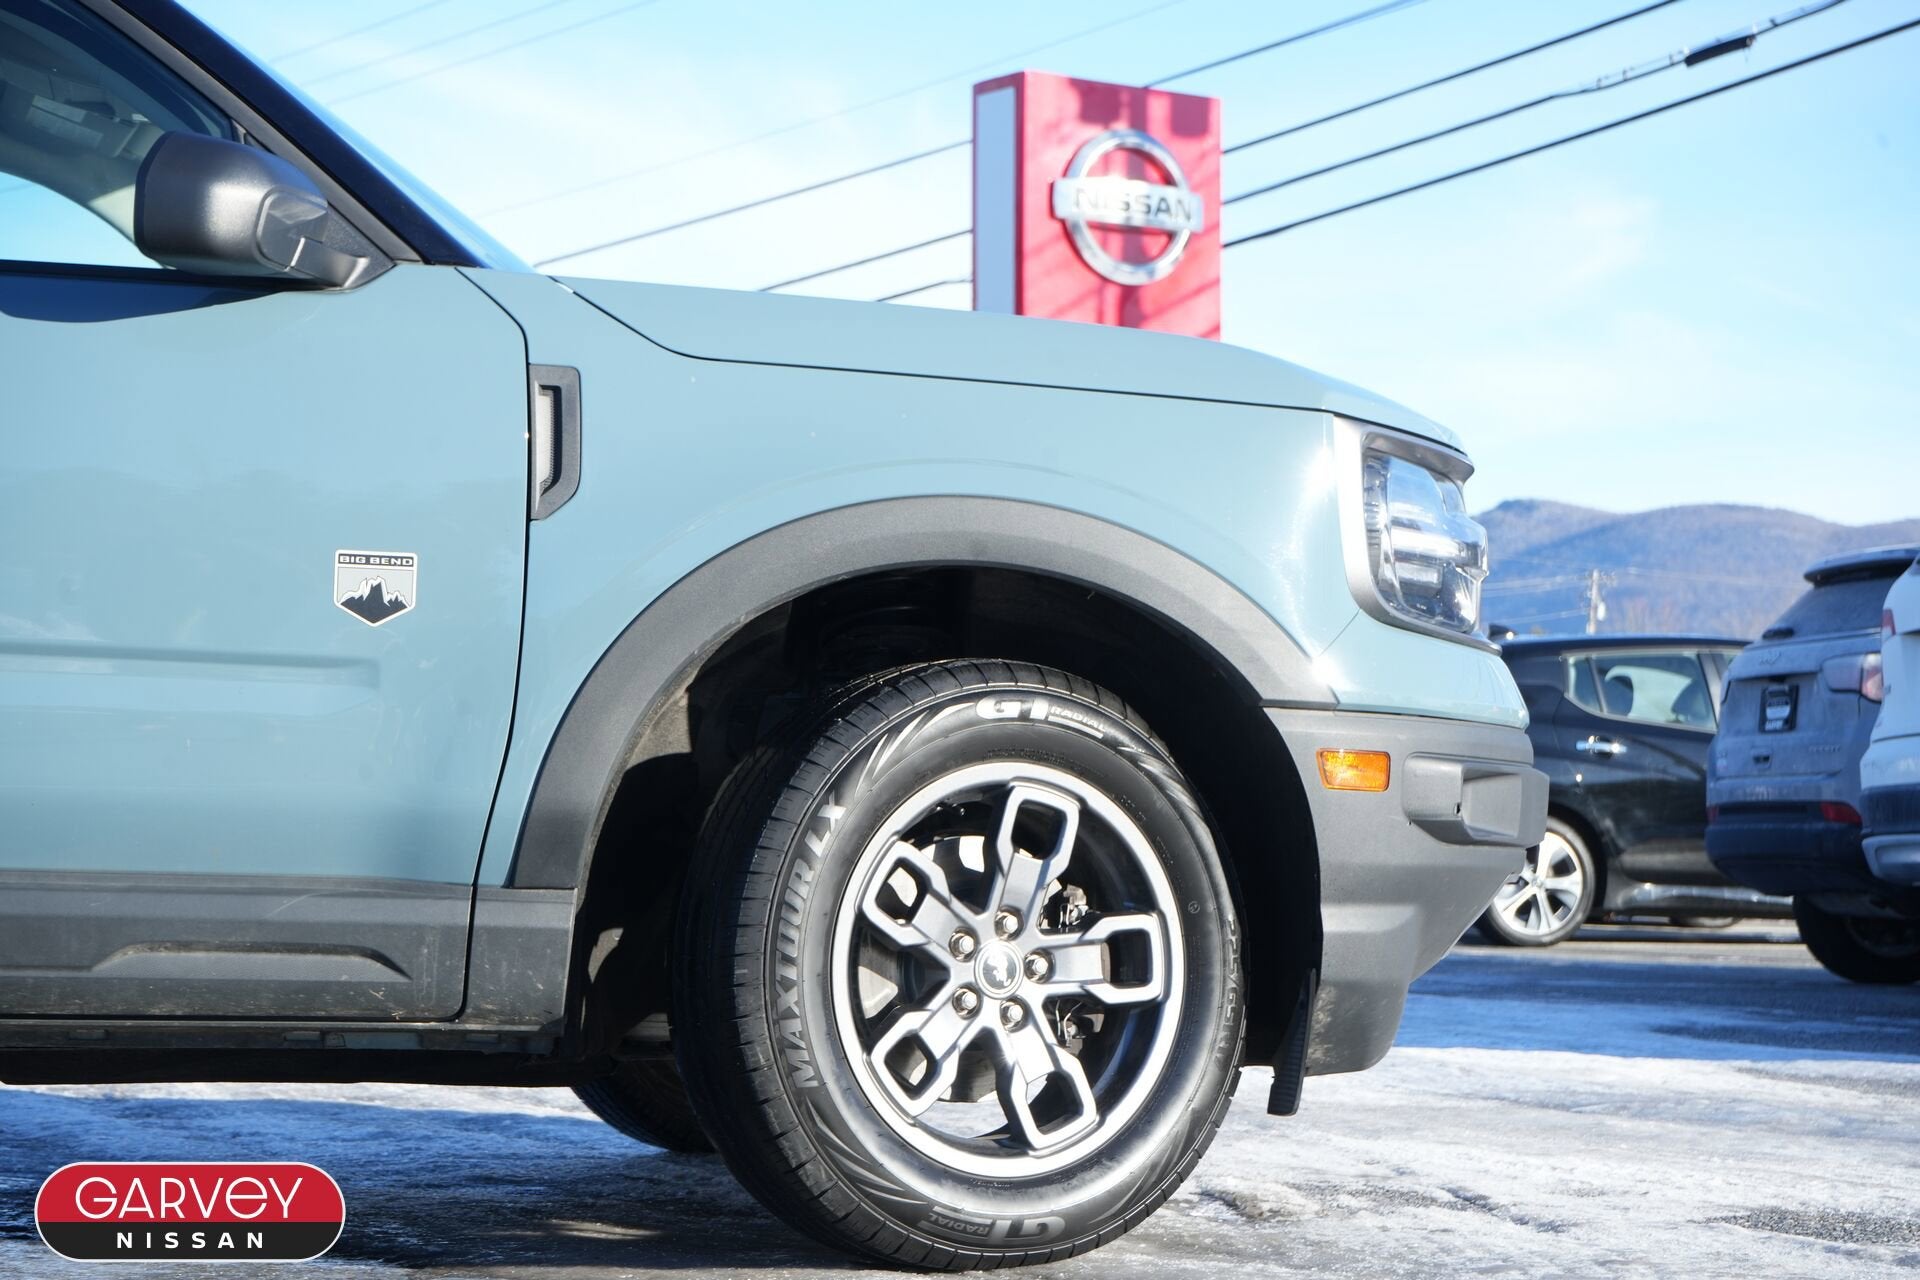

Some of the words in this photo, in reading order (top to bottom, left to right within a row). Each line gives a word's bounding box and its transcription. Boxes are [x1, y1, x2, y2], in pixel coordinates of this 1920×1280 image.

[1074, 187, 1192, 223] NISSAN
[339, 555, 366, 564] BIG
[369, 556, 413, 566] BEND
[1051, 704, 1106, 733] RADIAL
[776, 858, 819, 1088] MAXTOUR
[805, 790, 847, 858] LX
[929, 1212, 990, 1236] RADIAL
[987, 1216, 1066, 1245] GT
